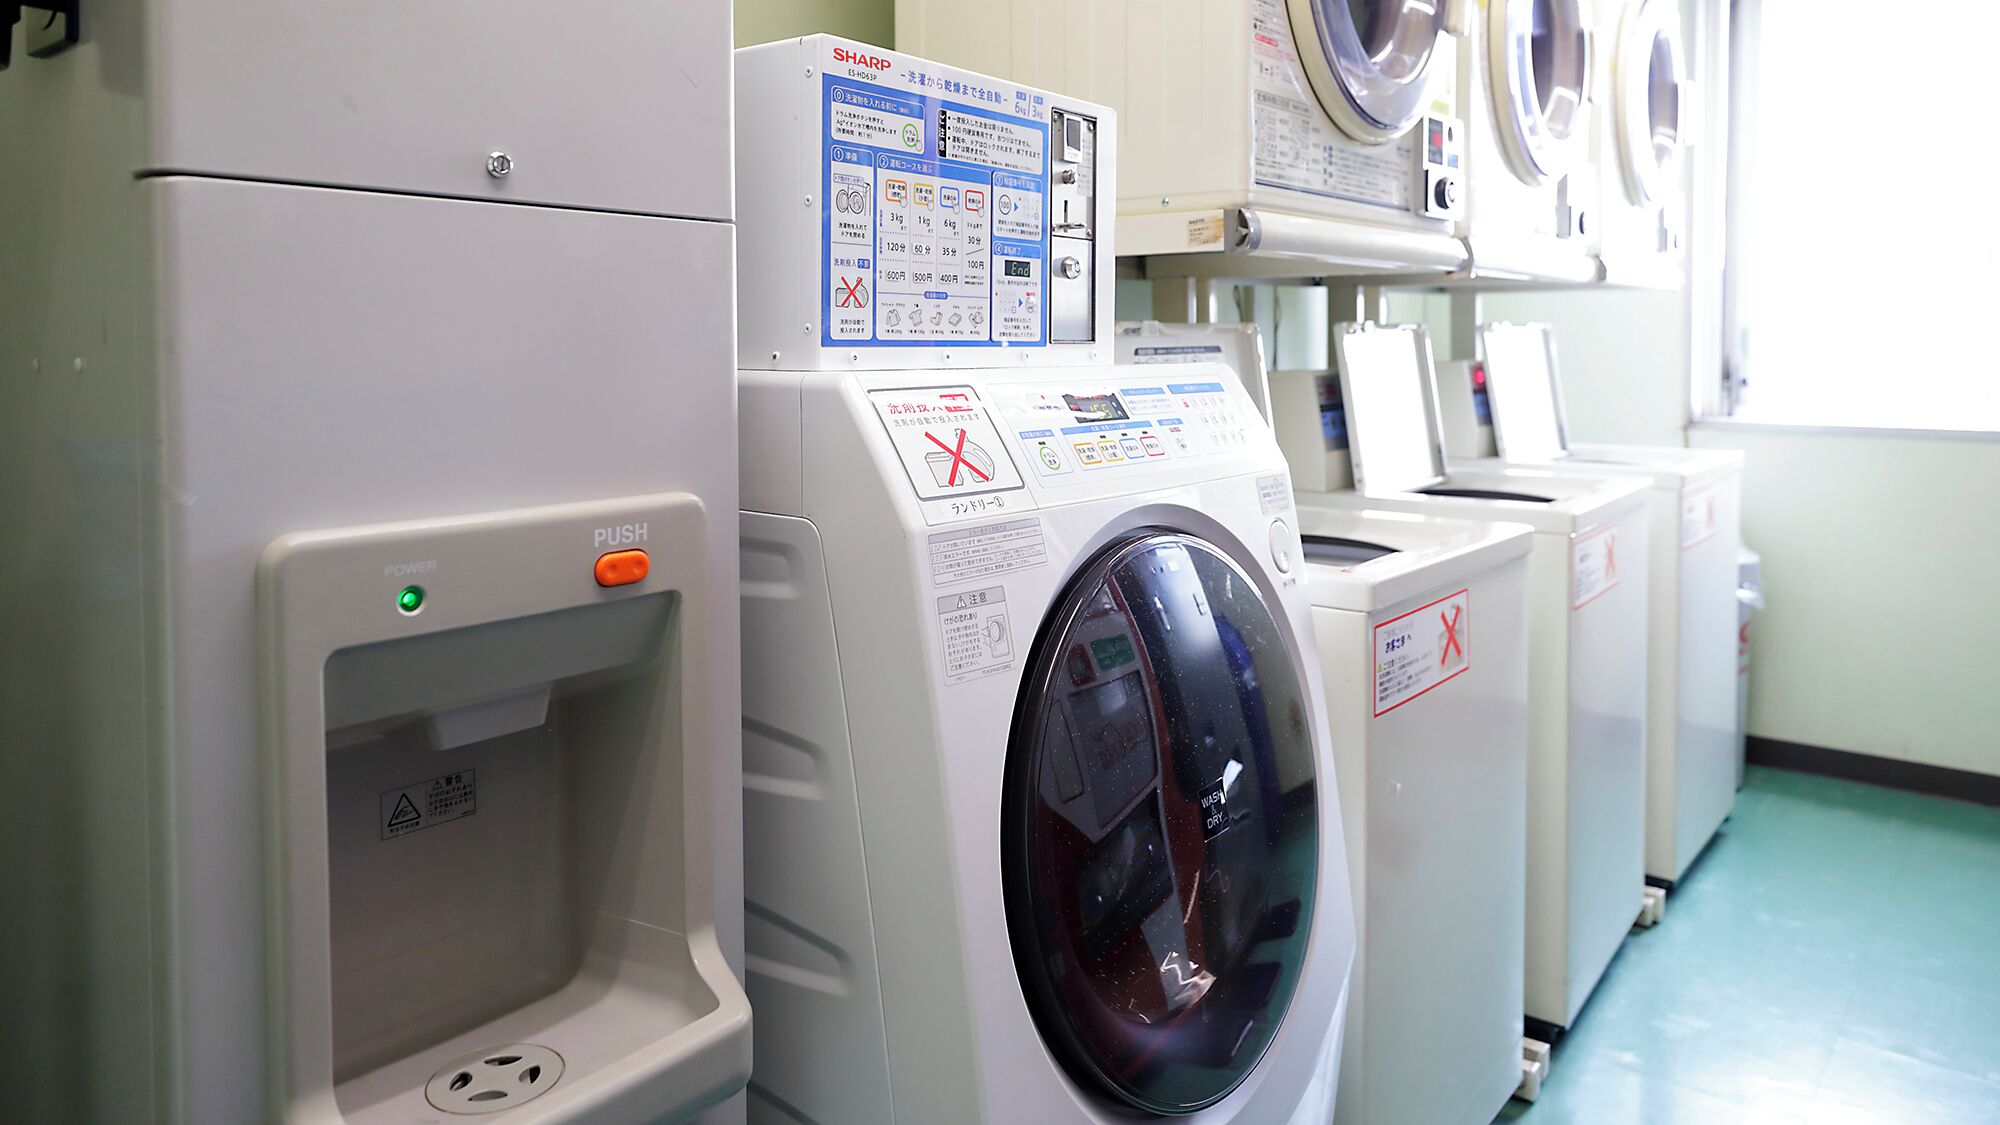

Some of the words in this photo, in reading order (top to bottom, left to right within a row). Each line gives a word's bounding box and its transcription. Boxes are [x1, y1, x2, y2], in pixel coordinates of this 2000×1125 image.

[833, 47, 892, 71] SHARP
[848, 68, 878, 81] ES-HD63P
[887, 242, 906, 253] 120分
[968, 236, 981, 246] 30分
[943, 247, 957, 257] 35分
[967, 260, 985, 270] 100円
[1011, 262, 1030, 276] End
[887, 270, 906, 281] 600円
[914, 272, 933, 282] 500円
[940, 274, 958, 284] 400円
[893, 413, 980, 428] 洗剤が自動で投入されます
[594, 523, 649, 548] PUSH
[384, 559, 437, 577] POWER
[969, 591, 987, 606] 注意
[943, 611, 978, 625] けがの恐れあり
[1206, 811, 1223, 829] DRY
